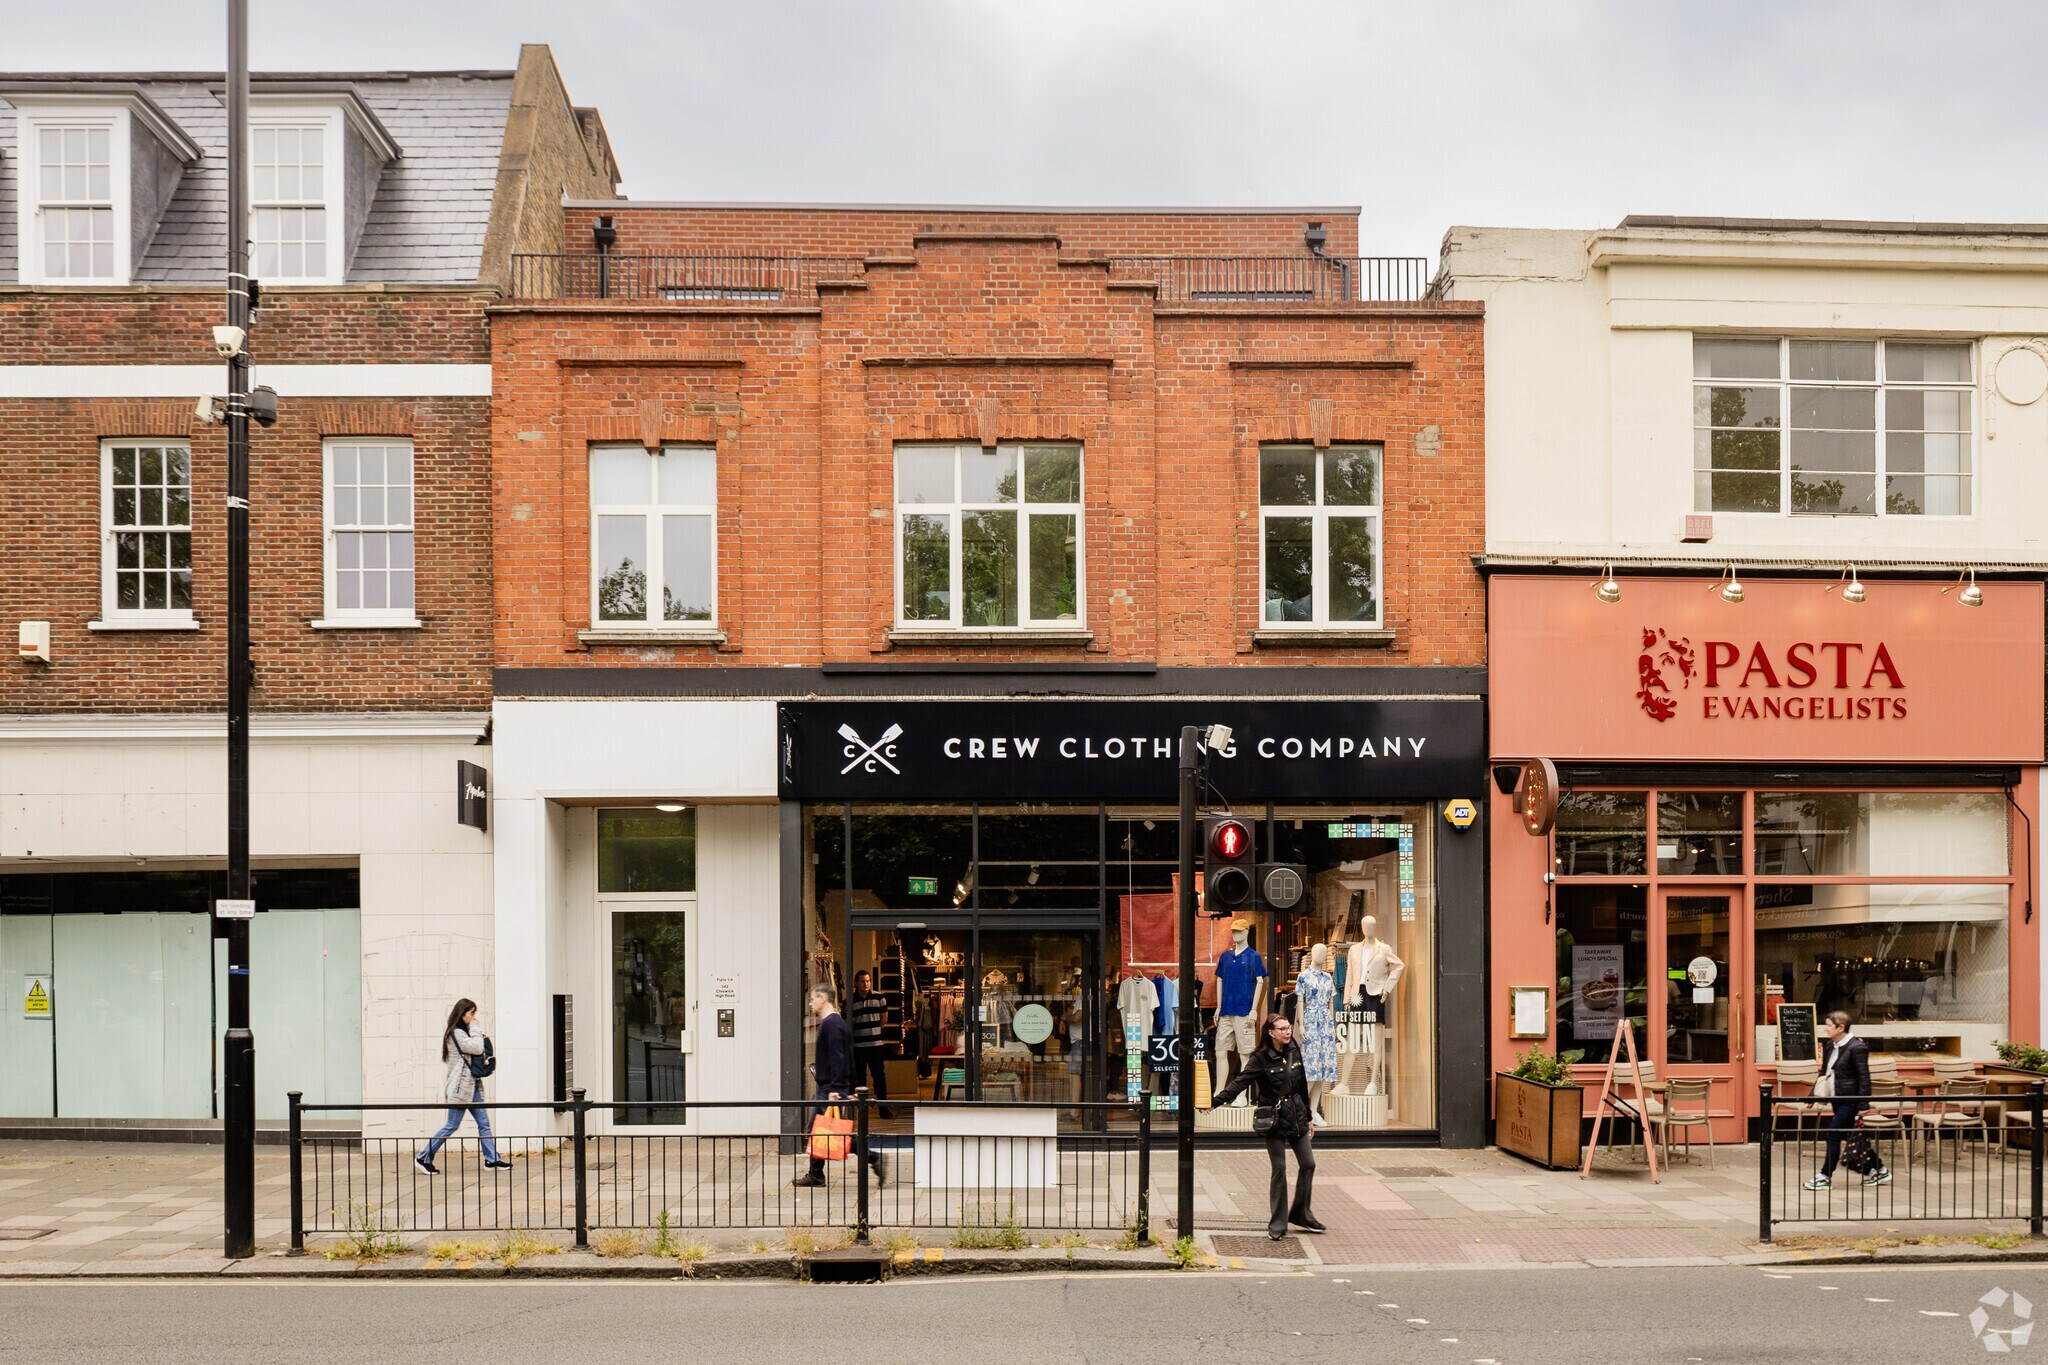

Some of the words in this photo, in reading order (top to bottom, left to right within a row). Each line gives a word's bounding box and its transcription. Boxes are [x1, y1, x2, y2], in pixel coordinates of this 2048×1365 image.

[1704, 641, 1906, 688] PASTA
[1703, 696, 1907, 720] EVANGELISTS
[943, 737, 1040, 759] CREW
[1257, 736, 1426, 759] COMPANY
[1455, 808, 1469, 817] ADT
[1335, 1011, 1348, 1022] GET
[1350, 1011, 1361, 1022] SET
[1363, 1011, 1376, 1022] FOR
[1336, 1023, 1376, 1054] SUN
[1511, 1121, 1532, 1142] PASTA
